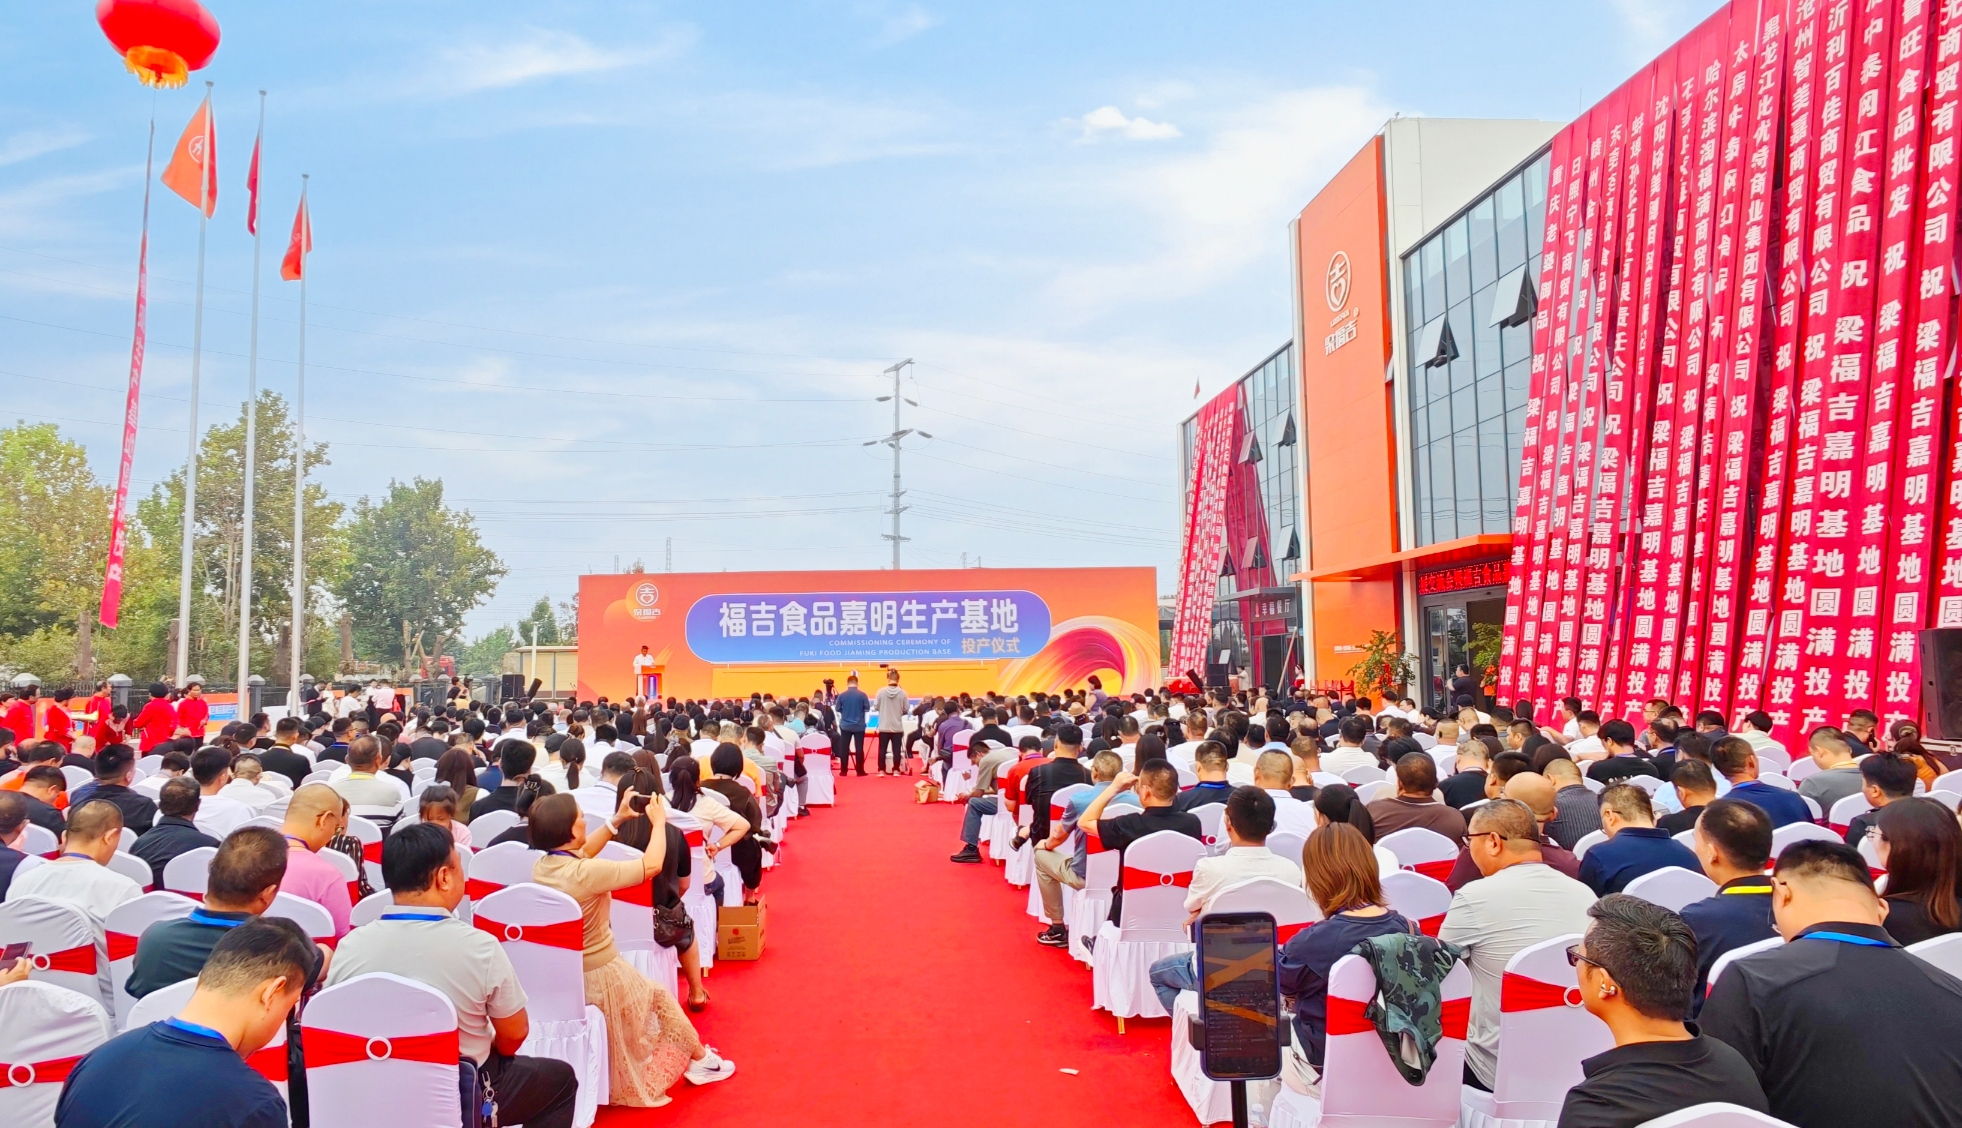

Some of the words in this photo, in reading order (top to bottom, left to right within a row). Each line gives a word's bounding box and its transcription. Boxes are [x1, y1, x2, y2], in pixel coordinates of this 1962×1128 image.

[1847, 0, 1882, 235] 中泰网红食品
[1735, 15, 1779, 381] 黑龙江比优特商业集团有限公司
[1884, 241, 1905, 275] 祝
[1551, 156, 1581, 394] 日照宁飞商贸有限公司
[1841, 260, 1867, 289] 祝
[1921, 266, 1944, 299] 祝
[1777, 343, 1791, 370] 祝
[1805, 333, 1825, 362] 祝
[1532, 353, 1544, 373] 祝
[1657, 383, 1672, 405] 祝
[1683, 389, 1697, 413] 祝
[1731, 395, 1746, 417] 祝
[1546, 410, 1557, 430] 祝
[1578, 407, 1594, 431] 祝
[1800, 316, 1864, 734] 梁福吉嘉明基地圆满投产
[1842, 300, 1901, 734] 梁福吉嘉明基地圆满投
[1519, 445, 1554, 692] 梁福吉嘉明基地圆满投
[1704, 431, 1744, 712] 梁福吉嘉明基地圆满投
[719, 598, 1018, 638] 福吉食品嘉明生产基地
[800, 649, 817, 657] FUKI
[819, 649, 842, 657] FOOD
[843, 649, 876, 657] JIAMING
[878, 648, 930, 656] PRODUCTION
[932, 648, 951, 656] BASE
[829, 639, 894, 647] COMMISSIONING
[896, 638, 942, 646] CEREMONY
[943, 638, 951, 646] OF
[961, 636, 1021, 654] 投产仪式
